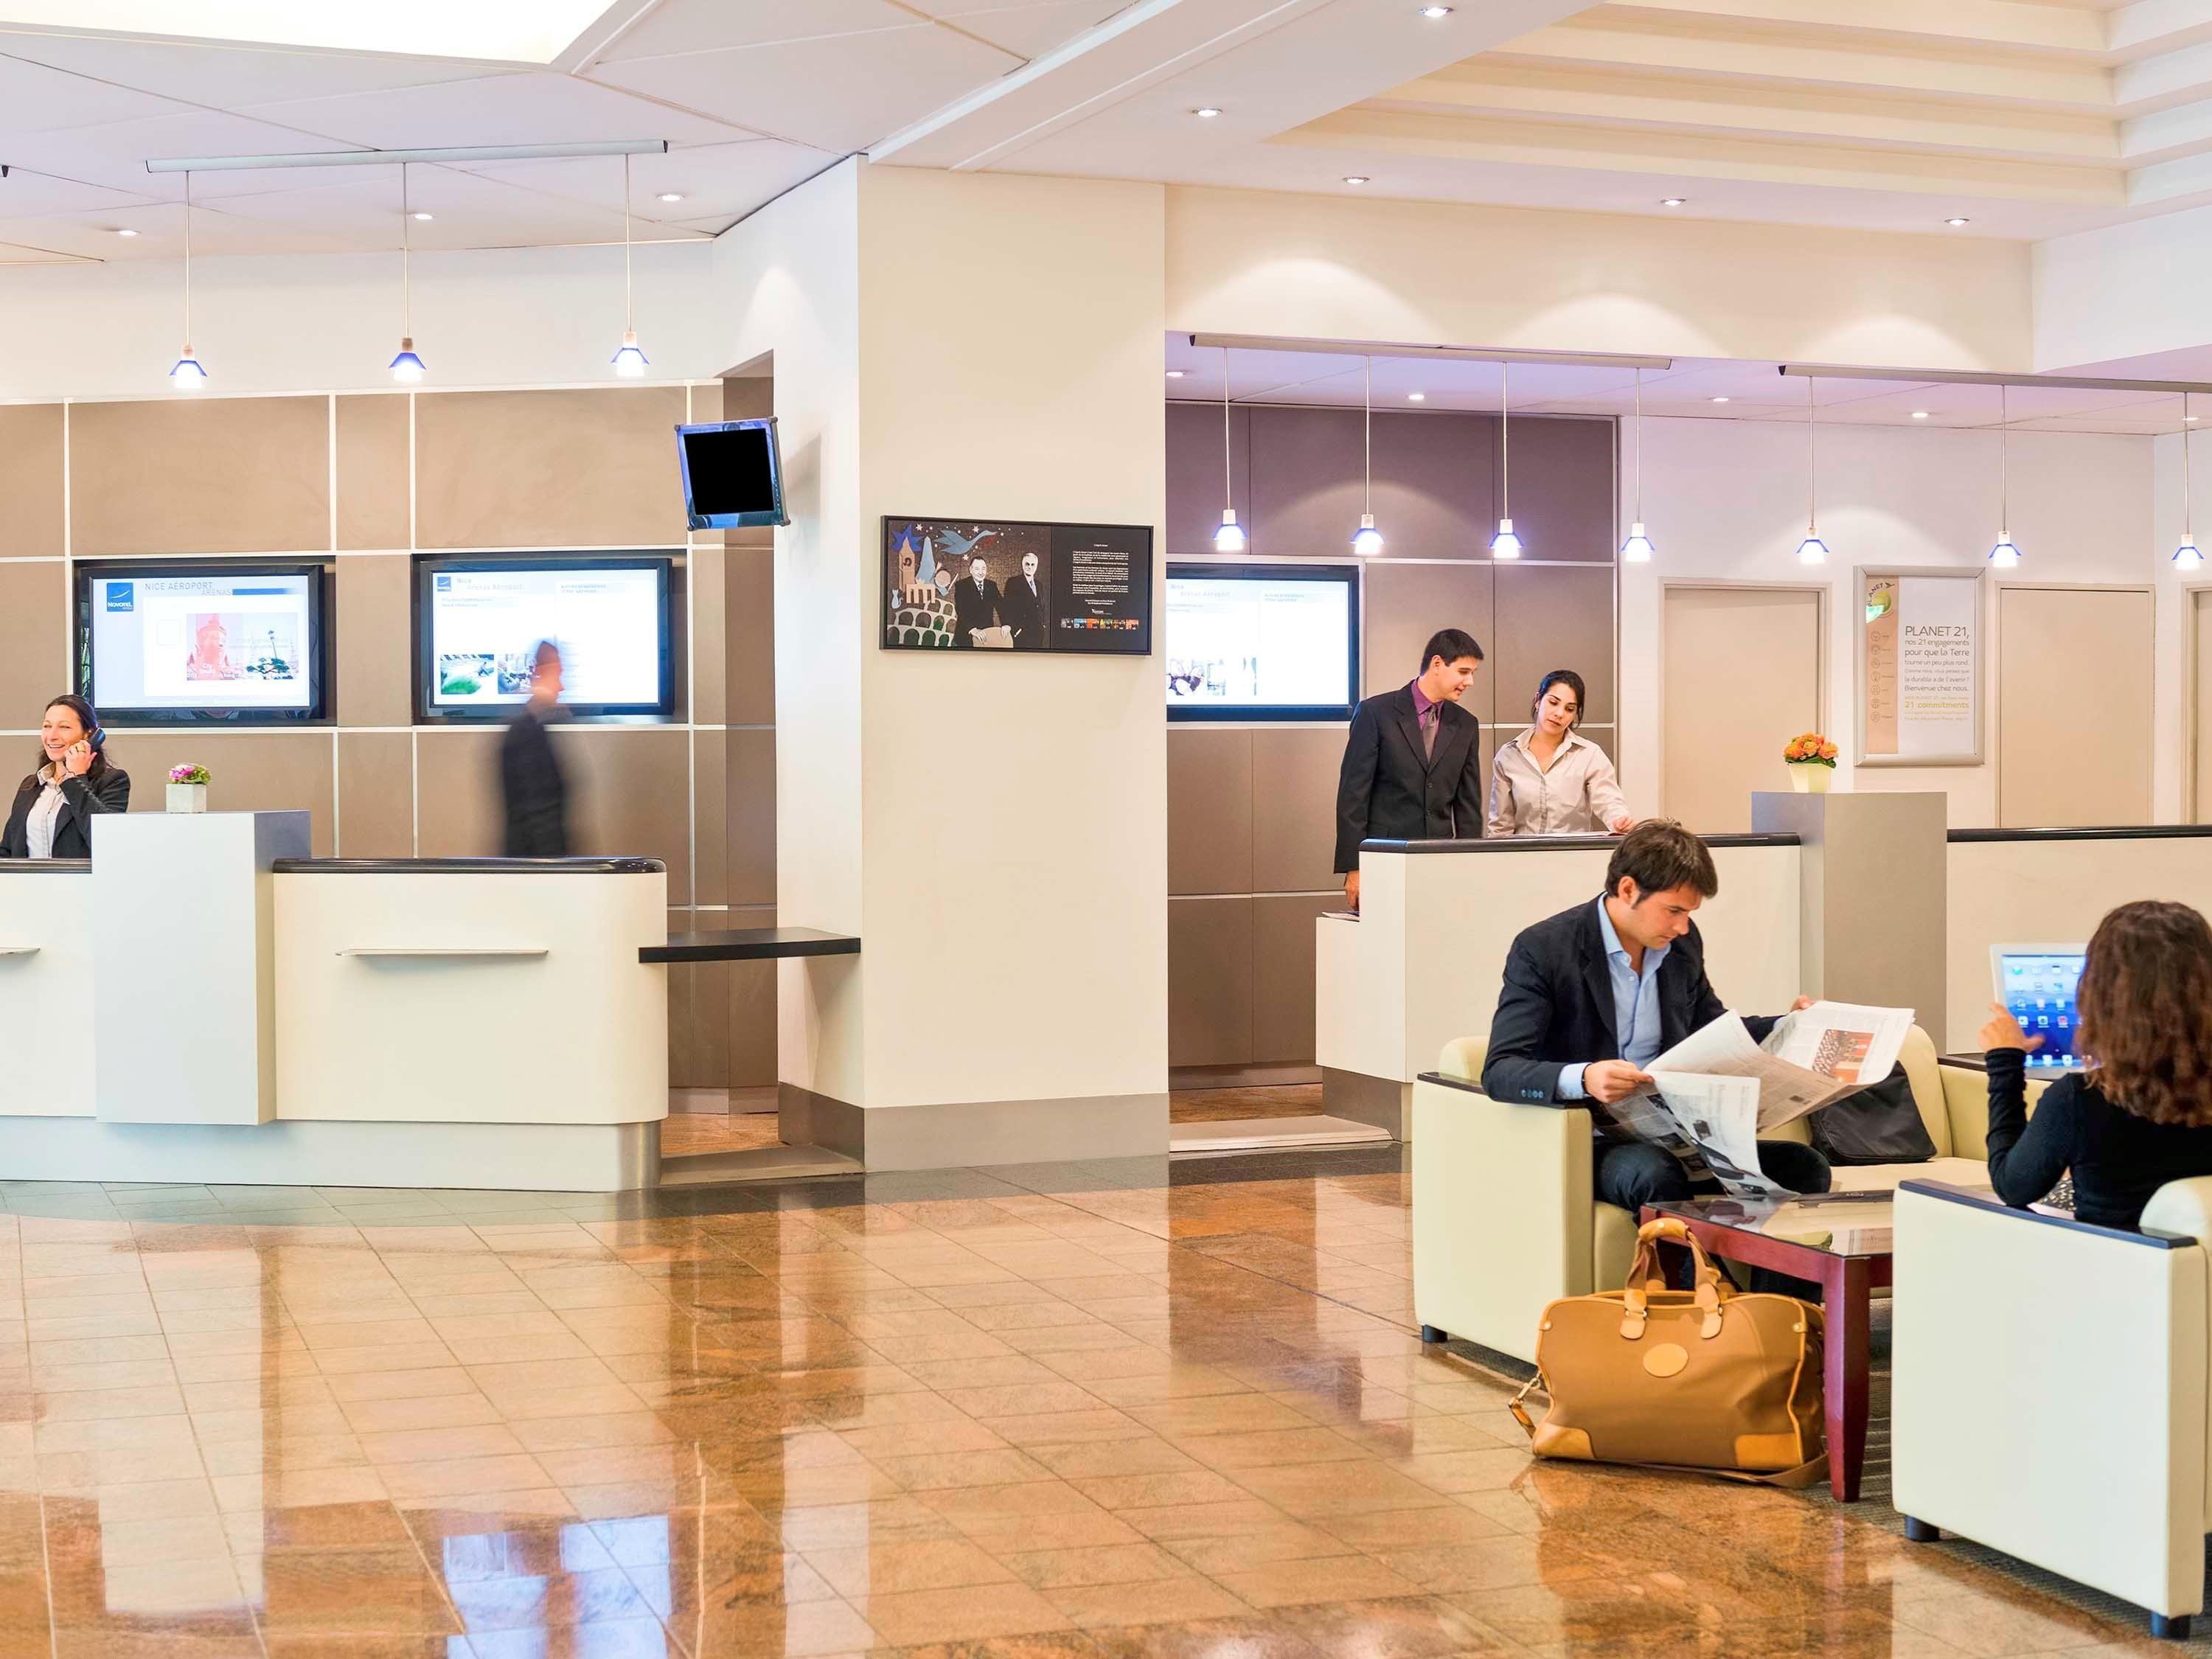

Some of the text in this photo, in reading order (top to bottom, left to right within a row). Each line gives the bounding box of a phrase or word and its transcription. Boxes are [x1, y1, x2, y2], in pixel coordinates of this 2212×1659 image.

[145, 582, 165, 591] NICE
[1867, 582, 1883, 607] PLANET
[1905, 625, 1969, 639] PLANET 21,
[1927, 639, 1969, 648] engagements
[1905, 647, 1969, 658] pour que la Terre
